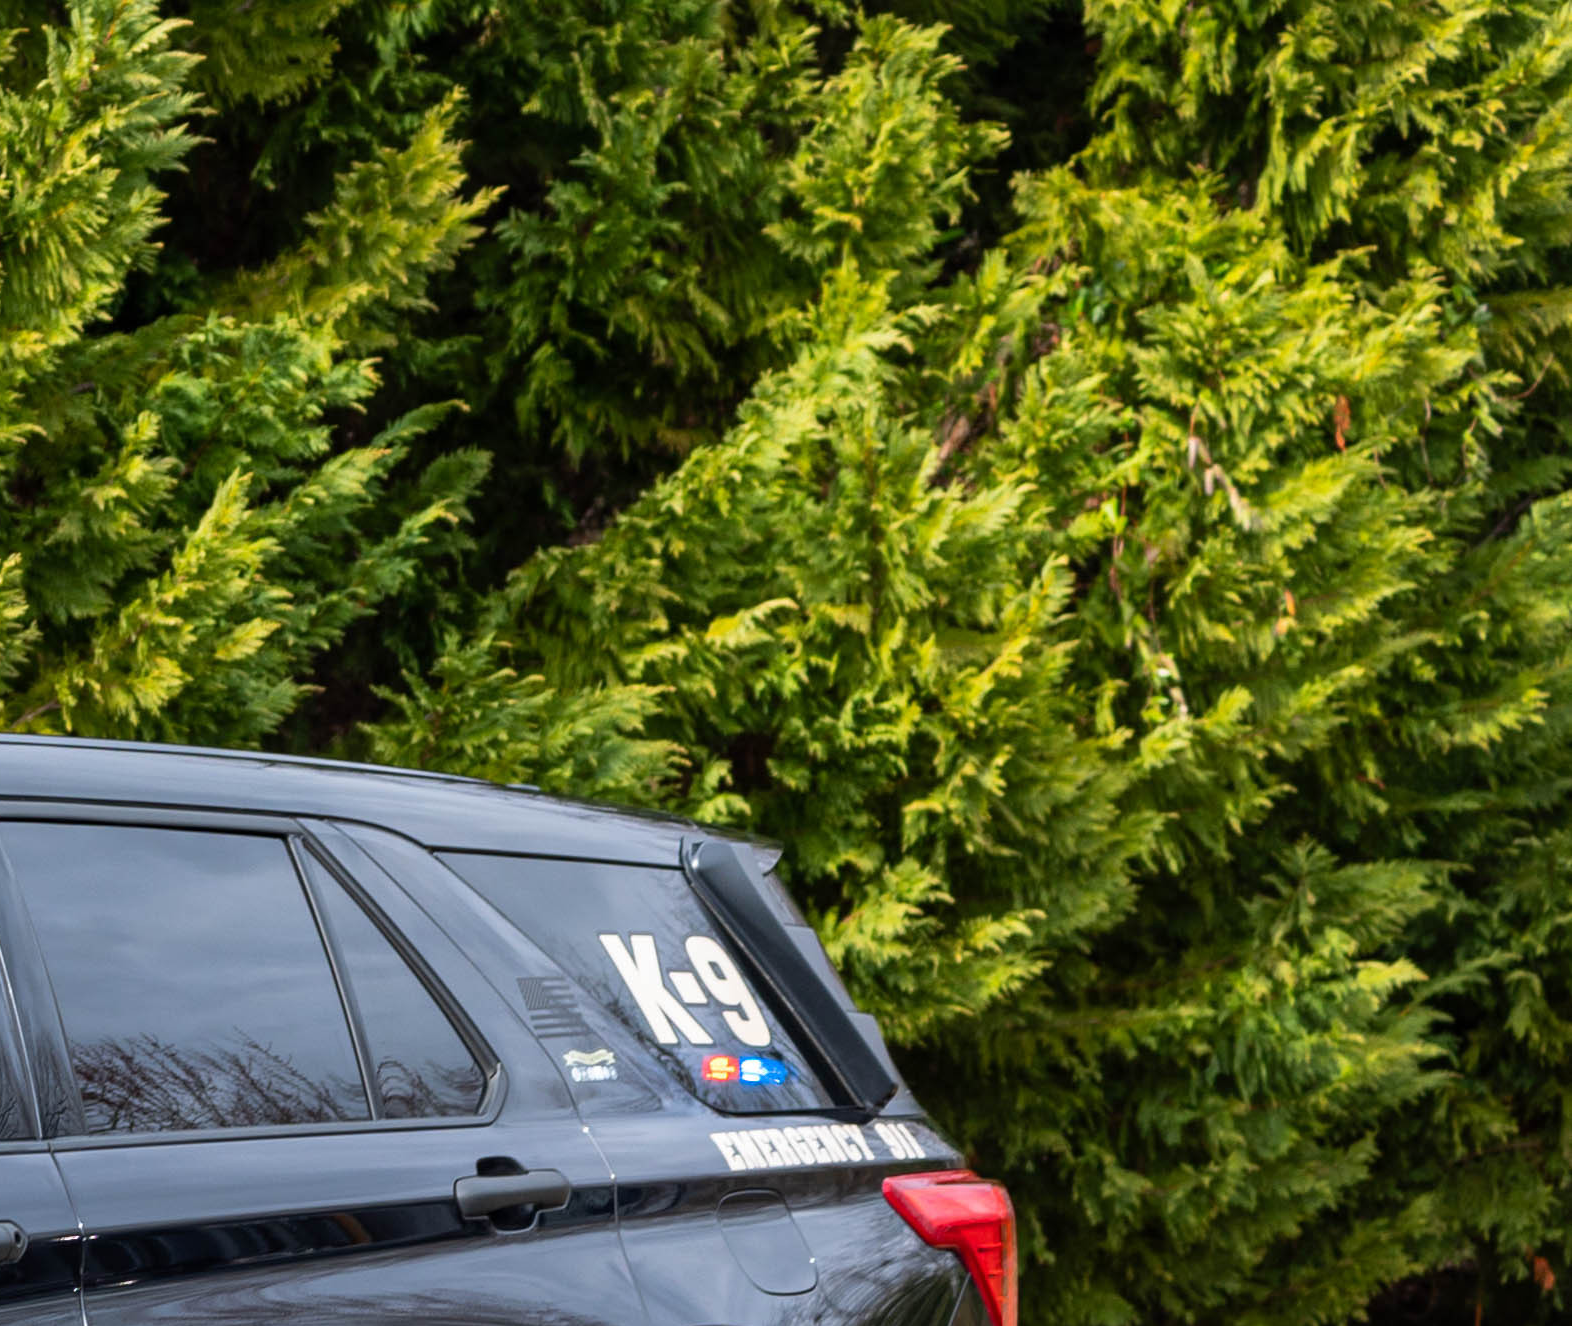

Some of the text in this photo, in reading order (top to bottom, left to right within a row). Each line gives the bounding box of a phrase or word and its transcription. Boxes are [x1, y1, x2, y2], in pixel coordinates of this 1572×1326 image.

[598, 933, 771, 1047] K-9
[710, 1123, 926, 1171] EMERGENCY 911
